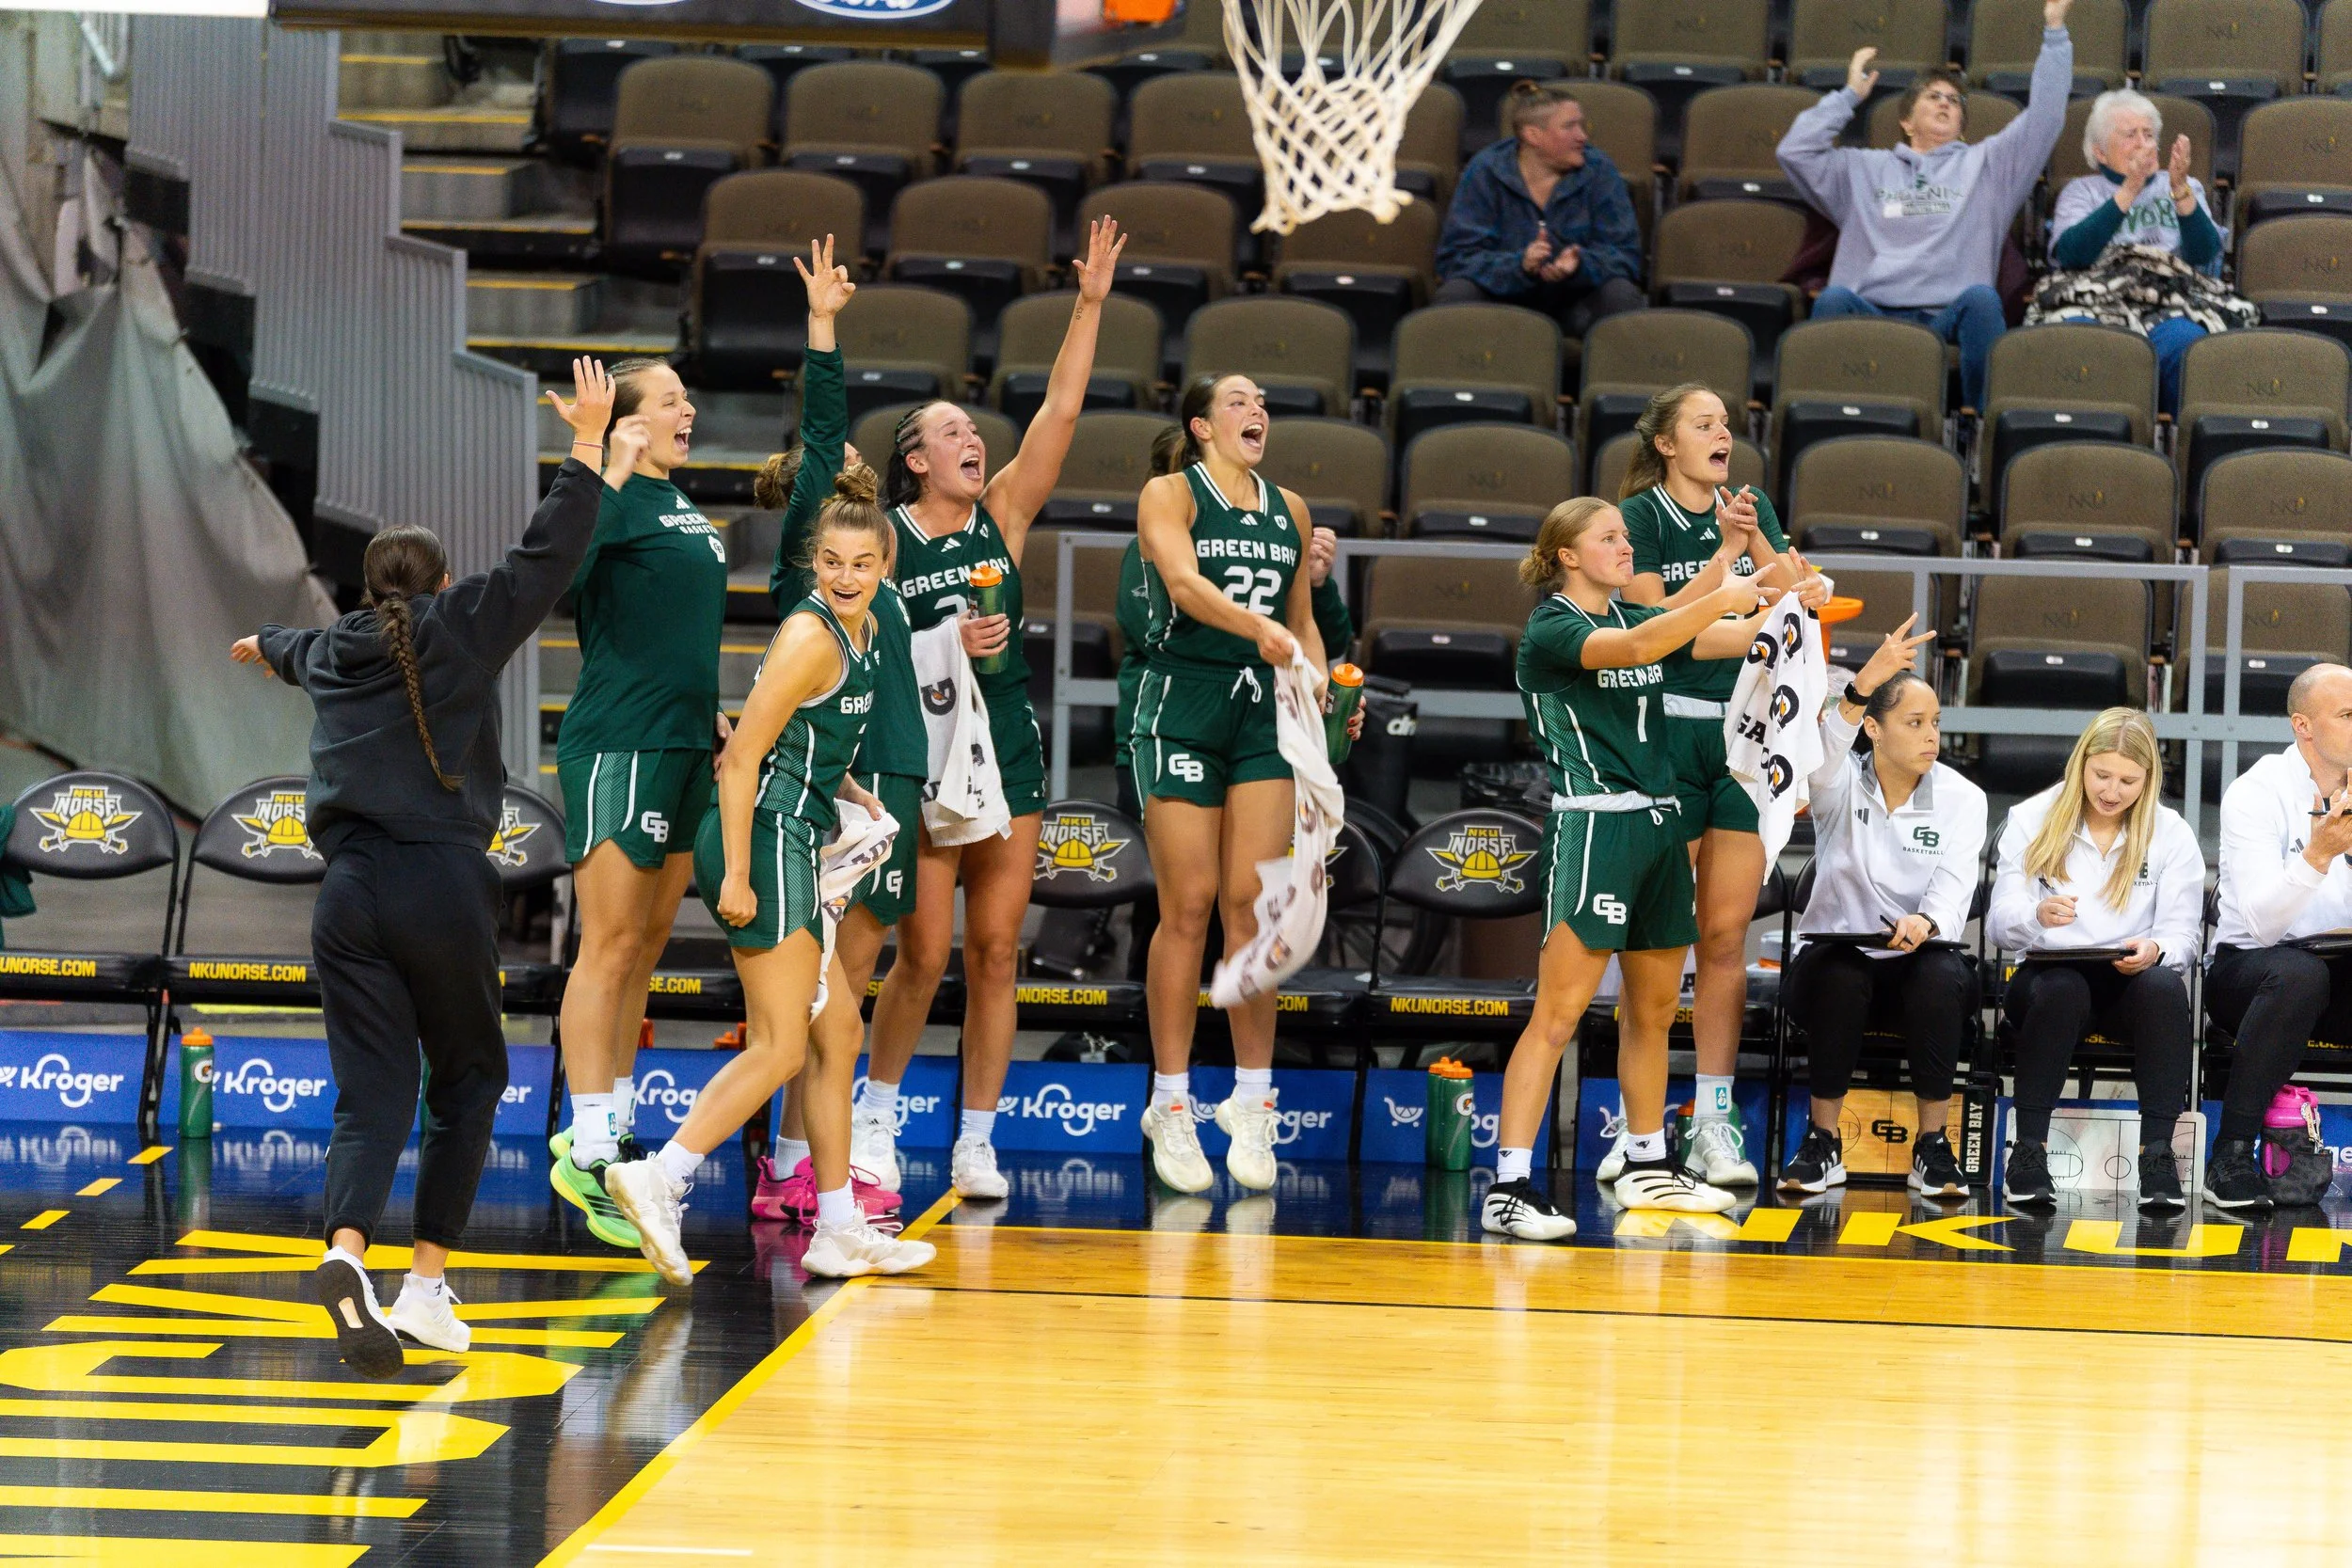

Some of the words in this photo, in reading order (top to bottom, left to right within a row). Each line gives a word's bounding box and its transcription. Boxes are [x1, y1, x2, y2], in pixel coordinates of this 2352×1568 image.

[1196, 539, 1266, 560] GREEN
[1270, 543, 1299, 567] BAY
[1733, 557, 1756, 575] BA
[901, 564, 972, 599] GREEN
[1223, 565, 1282, 616] 22
[1597, 667, 1646, 689] GREEN
[1647, 662, 1663, 685] BA
[1637, 696, 1647, 743] 1
[1168, 753, 1204, 783] GB
[73, 789, 104, 799] NKU
[275, 794, 305, 804] NKU
[257, 802, 307, 824] NORS
[1059, 816, 1091, 826] NKU
[641, 811, 669, 843] GB
[1468, 828, 1499, 837] NKU
[1913, 826, 1940, 847] GB
[1902, 846, 1945, 856] BASKETBALL
[1593, 894, 1627, 926] GB
[0, 956, 96, 978] UNORSE.COM
[189, 962, 307, 983] NKUNORSE.COM
[648, 975, 702, 995] SE.COM
[1015, 988, 1107, 1006] UNORSE.COM
[1391, 997, 1510, 1017] NKUNORSE.COM
[21, 1053, 124, 1108] Kroger
[224, 1058, 327, 1113] Kroger
[632, 1069, 699, 1125] Krog
[1023, 1084, 1126, 1136] Kroger
[1969, 1102, 1983, 1128] BAY
[1871, 1119, 1908, 1144] GB
[1965, 1132, 1981, 1173] GREEN
